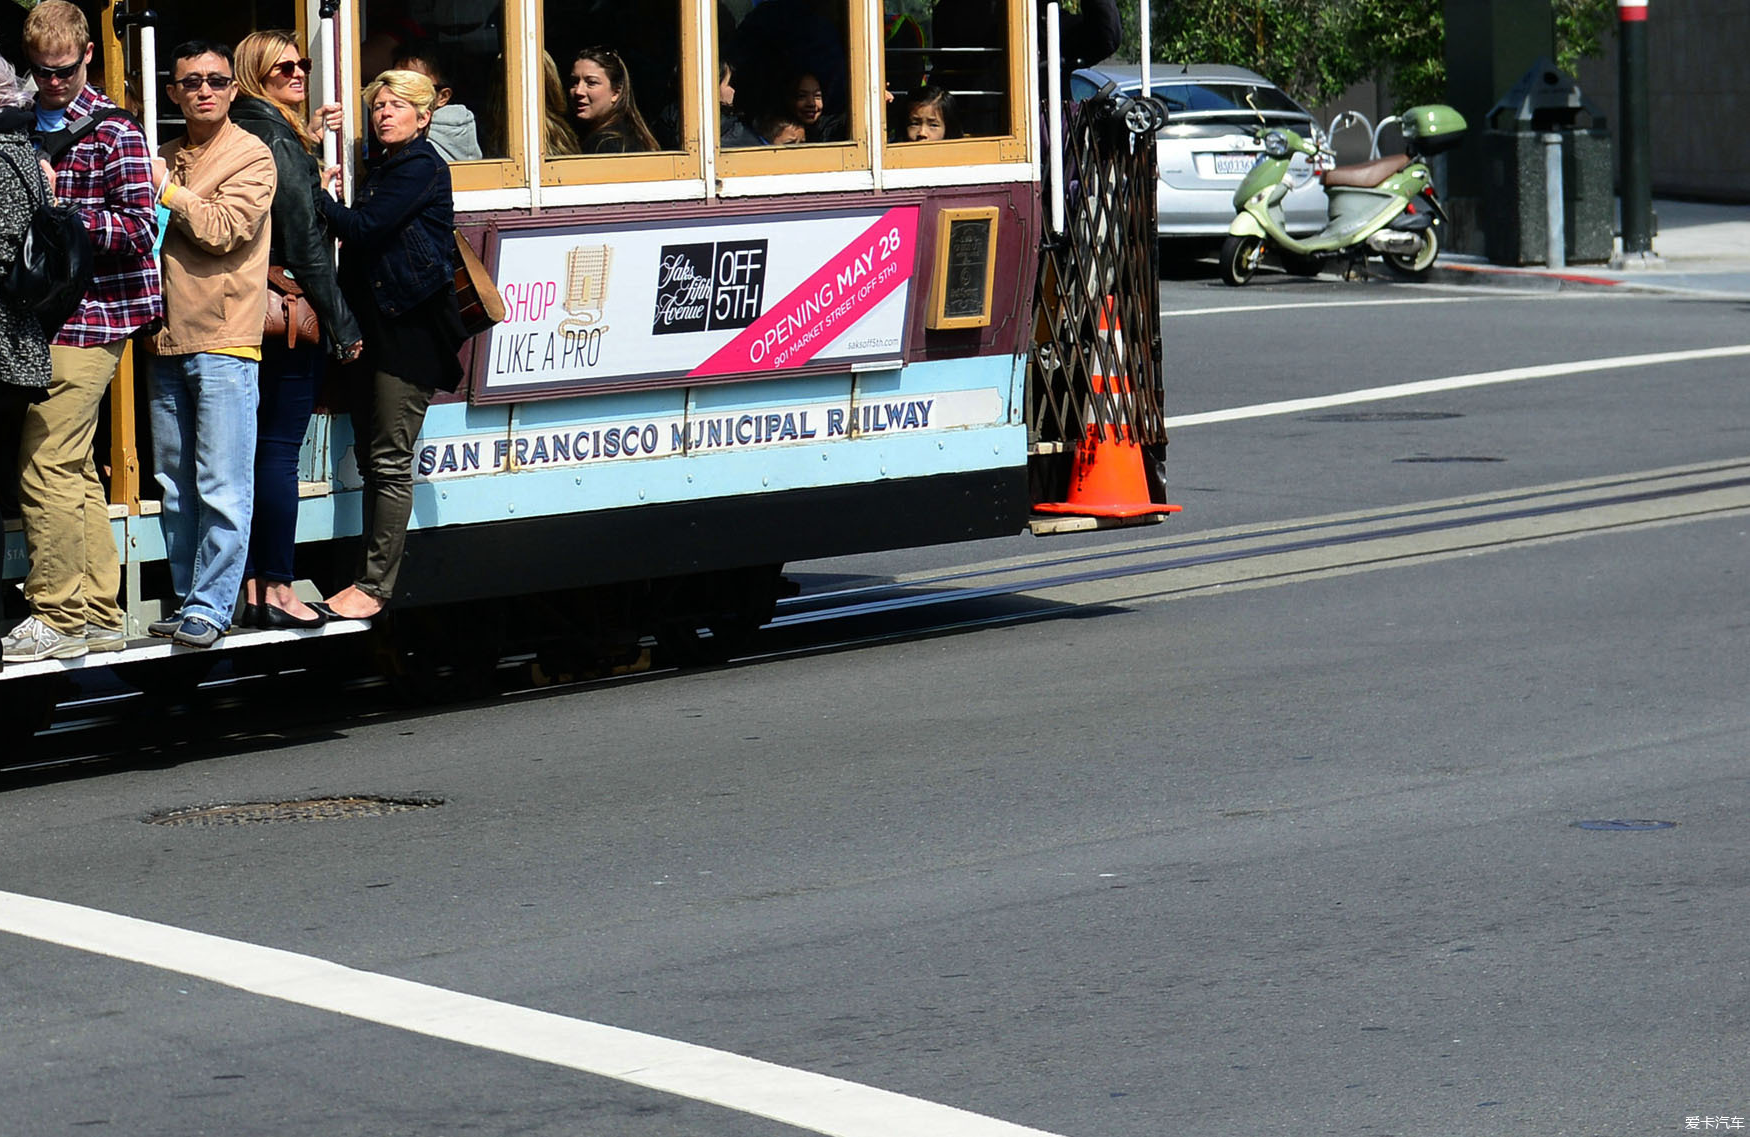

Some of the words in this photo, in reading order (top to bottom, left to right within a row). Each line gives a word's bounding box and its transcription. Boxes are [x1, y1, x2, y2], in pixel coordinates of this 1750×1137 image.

[657, 254, 695, 289] Saks
[719, 249, 763, 285] OFF
[503, 281, 557, 324] SHOP
[653, 293, 705, 325] Avenue
[715, 284, 759, 320] 5TH
[749, 283, 834, 363] OPENING
[836, 246, 874, 295] MAY
[878, 227, 901, 261] 28
[773, 349, 790, 368] 901
[789, 322, 824, 355] MARKET
[825, 296, 856, 327] STREET
[857, 277, 877, 302] (OFF
[878, 261, 898, 284] 5TH)
[496, 332, 539, 374] LIKE
[542, 331, 555, 370] A
[561, 328, 601, 369] PRO
[418, 440, 480, 476] SAN
[493, 423, 658, 469] FRANCISCO
[671, 411, 817, 451] MUNICIPAL
[827, 400, 934, 437] RAILWAY
